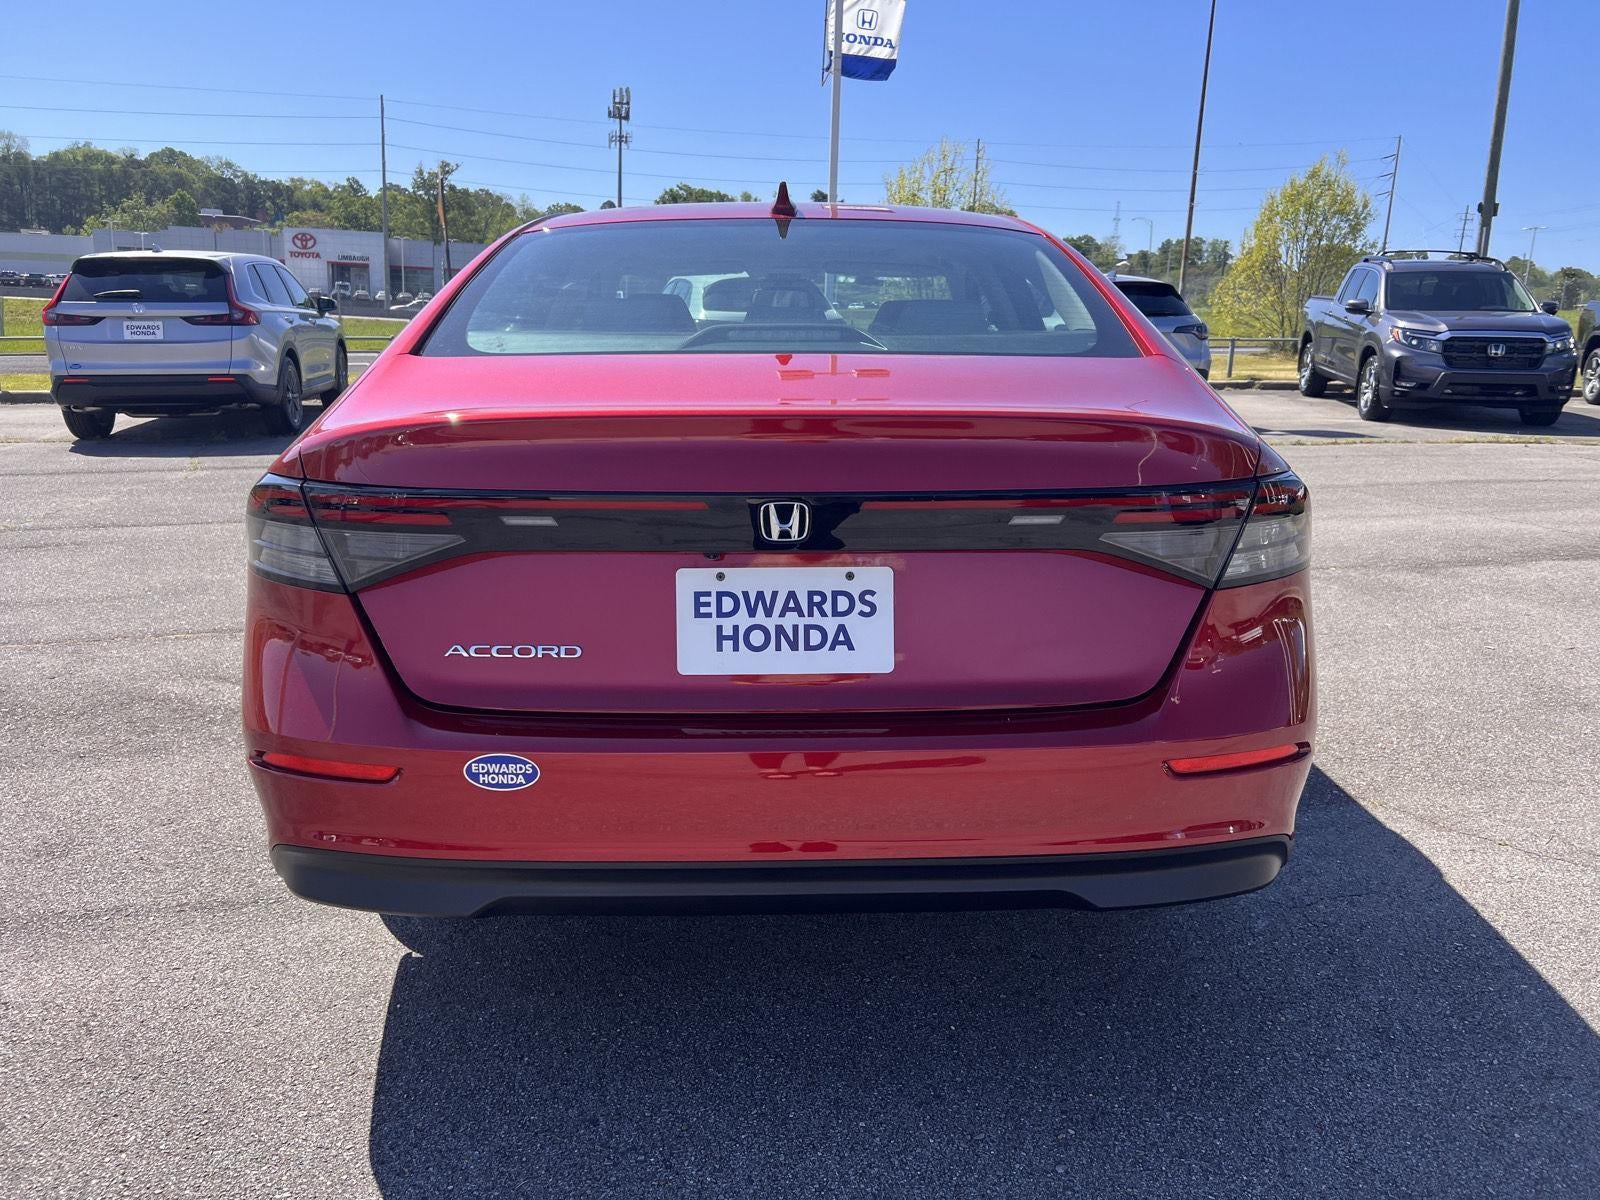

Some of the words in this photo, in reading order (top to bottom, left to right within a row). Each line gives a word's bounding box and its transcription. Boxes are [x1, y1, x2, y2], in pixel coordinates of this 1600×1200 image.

[841, 32, 895, 49] ONDA
[289, 251, 321, 259] TOYOTA
[337, 254, 369, 262] LIMBAUGH
[693, 589, 878, 619] EDWARDS
[715, 623, 856, 653] HONDA
[444, 644, 582, 658] ACCORD
[471, 763, 533, 774] EDWARDS
[479, 774, 526, 785] HONDA
